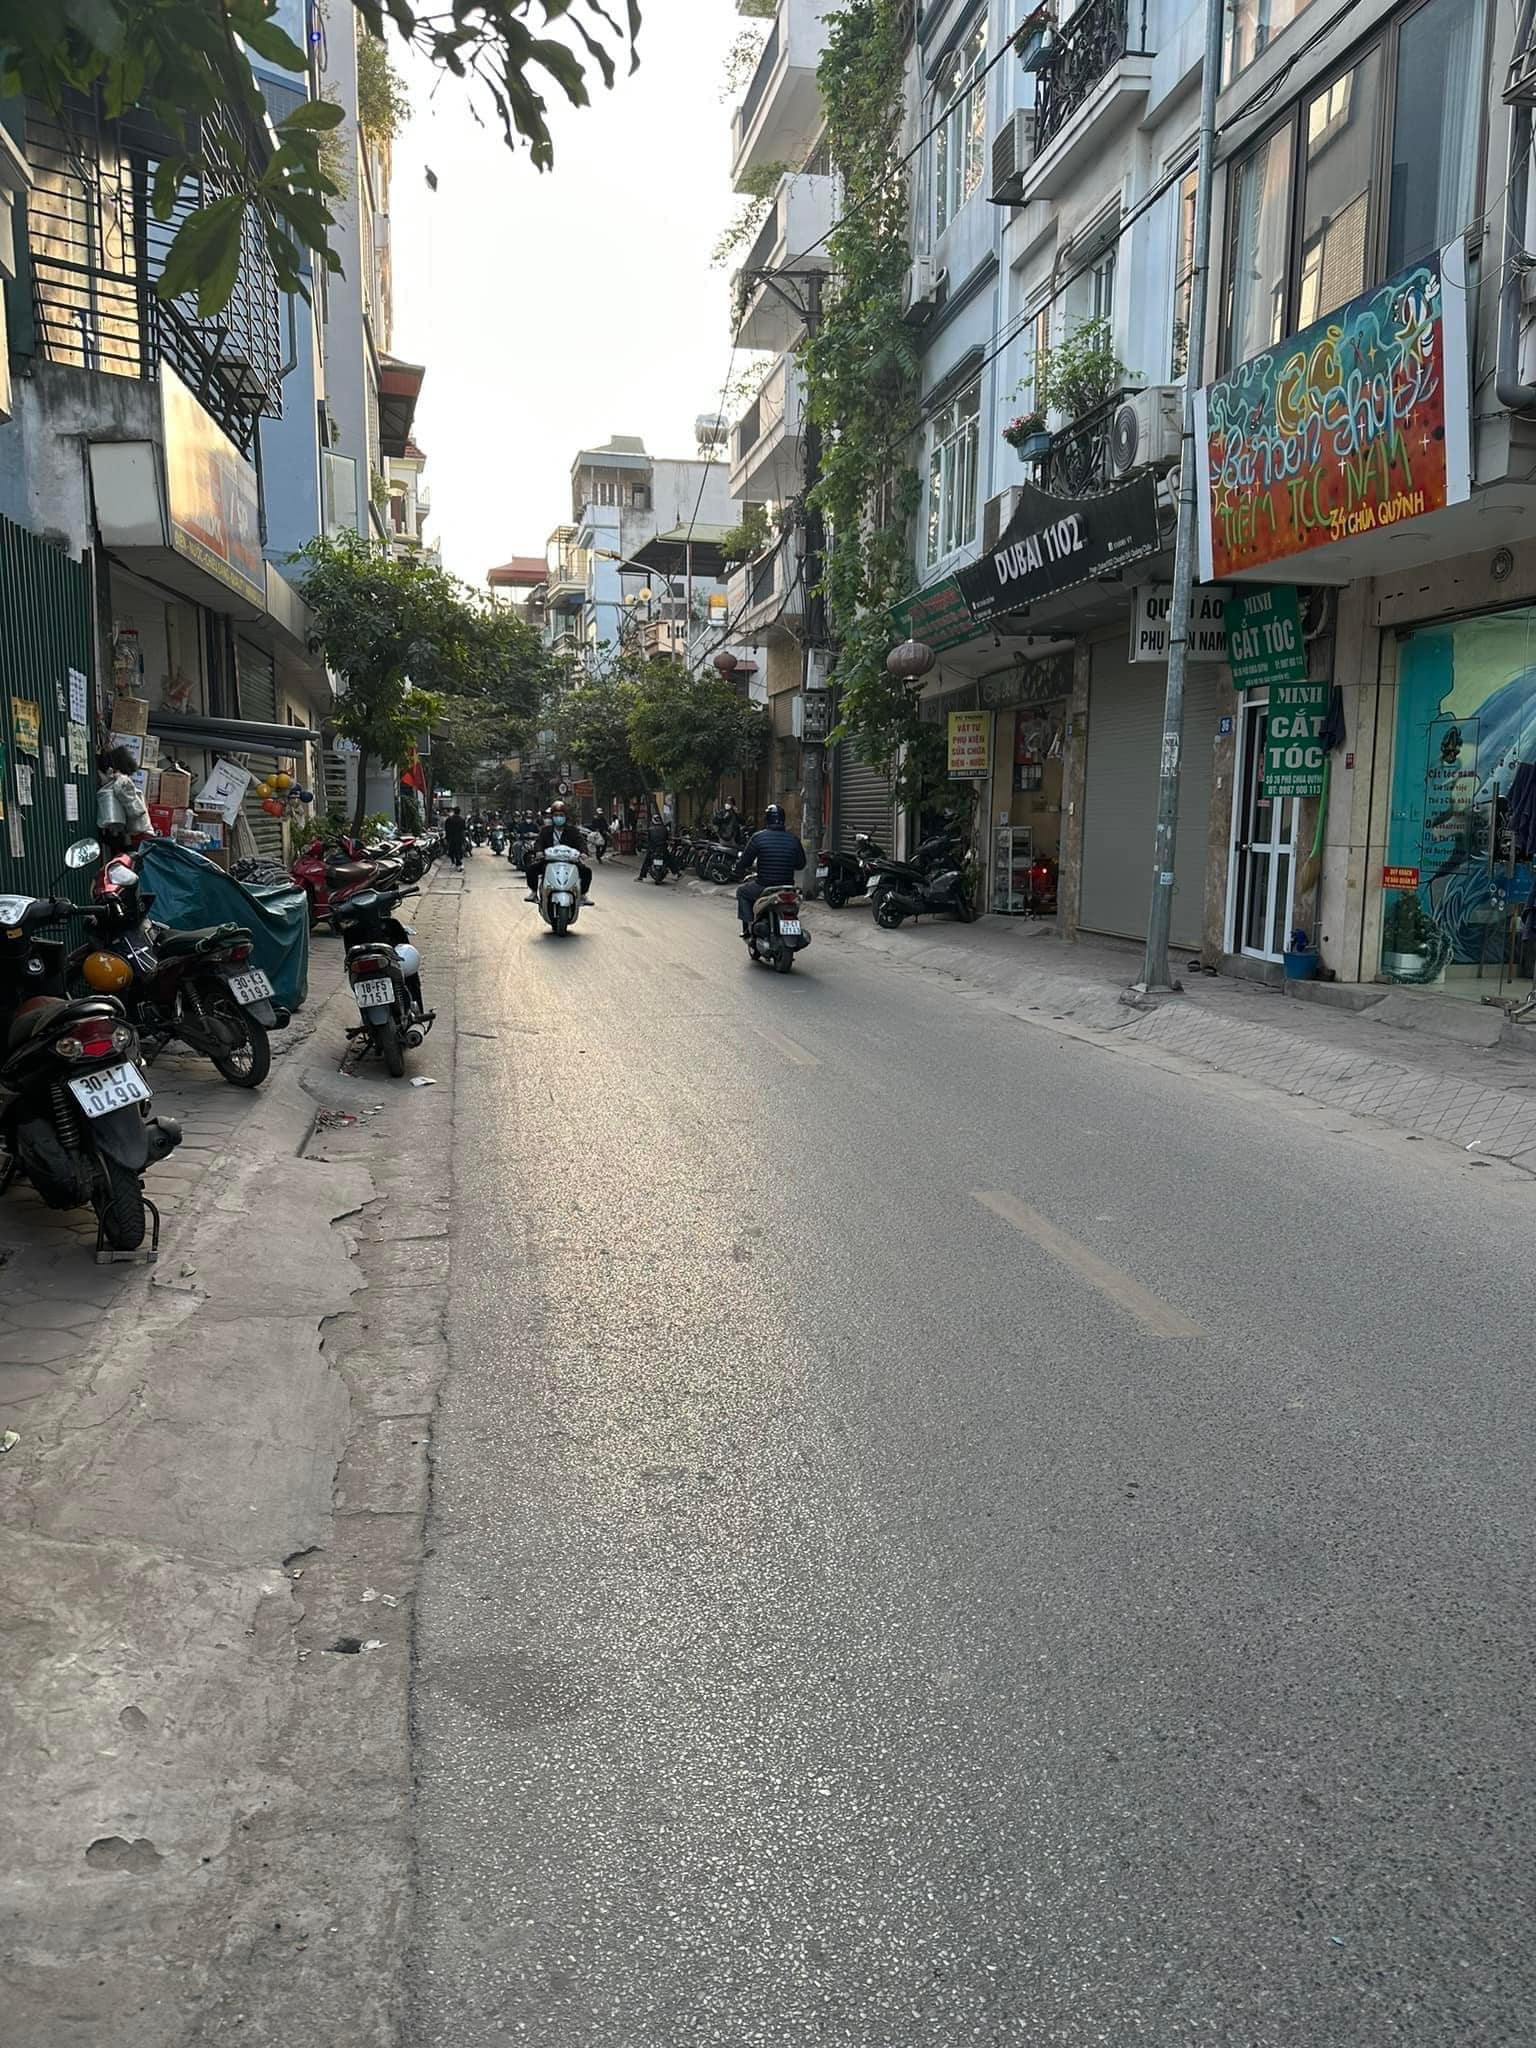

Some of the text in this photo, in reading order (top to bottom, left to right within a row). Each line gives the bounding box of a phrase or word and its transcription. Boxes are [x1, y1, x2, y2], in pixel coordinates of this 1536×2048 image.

[1346, 428, 1412, 512] NAM
[1329, 506, 1346, 540] 34
[994, 513, 1084, 585] DUBAI 1102
[1200, 595, 1224, 620] ÁO
[1140, 630, 1164, 655] PHỤ
[1199, 631, 1227, 651] NAM
[1231, 617, 1261, 661] CẮT
[1262, 616, 1296, 654] TÓC
[1277, 687, 1324, 703] MINH
[1271, 708, 1327, 738] CẮT
[1269, 743, 1324, 769] TÓC
[233, 972, 264, 990] 30-K3
[240, 984, 270, 1002] 9193
[80, 1065, 127, 1095] 30-L7
